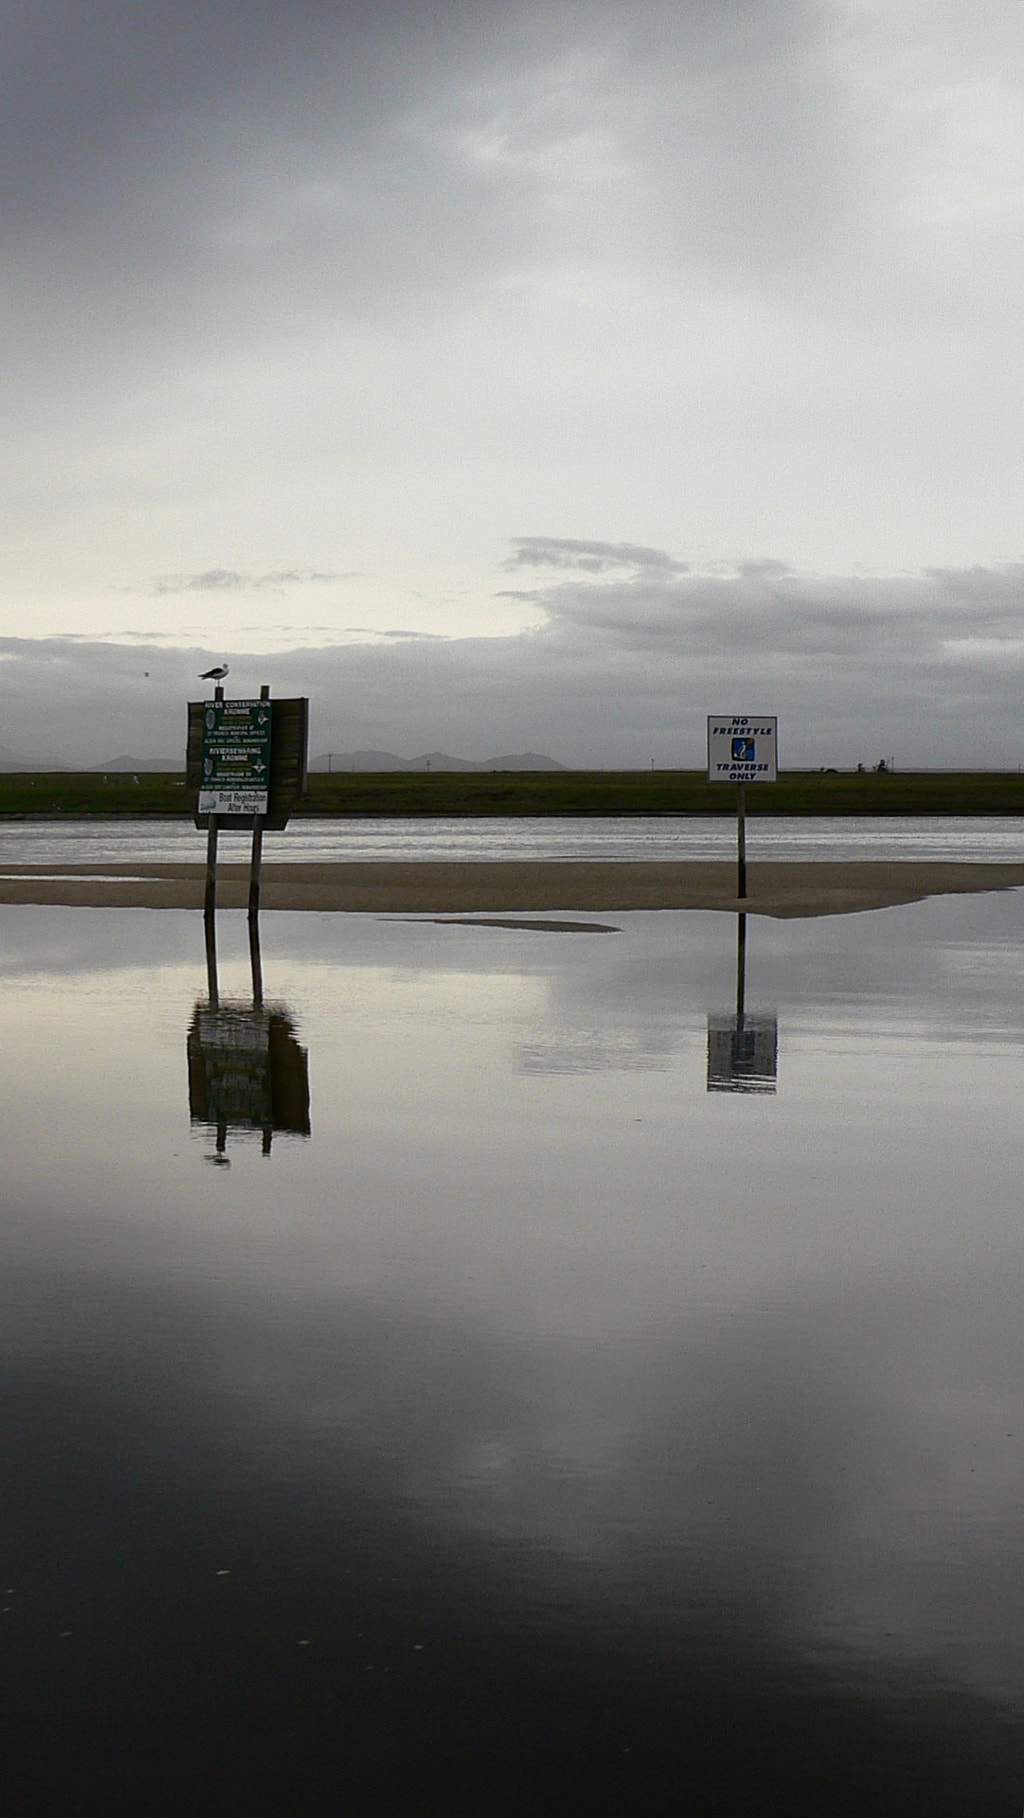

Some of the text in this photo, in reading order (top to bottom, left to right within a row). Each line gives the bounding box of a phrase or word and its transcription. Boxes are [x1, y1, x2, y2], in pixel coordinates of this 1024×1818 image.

[732, 718, 748, 726] NO
[713, 727, 772, 735] FREESTYLE
[717, 763, 769, 771] TRAVERSE
[219, 792, 266, 803] Boat Registration
[228, 803, 260, 812] After Hours
